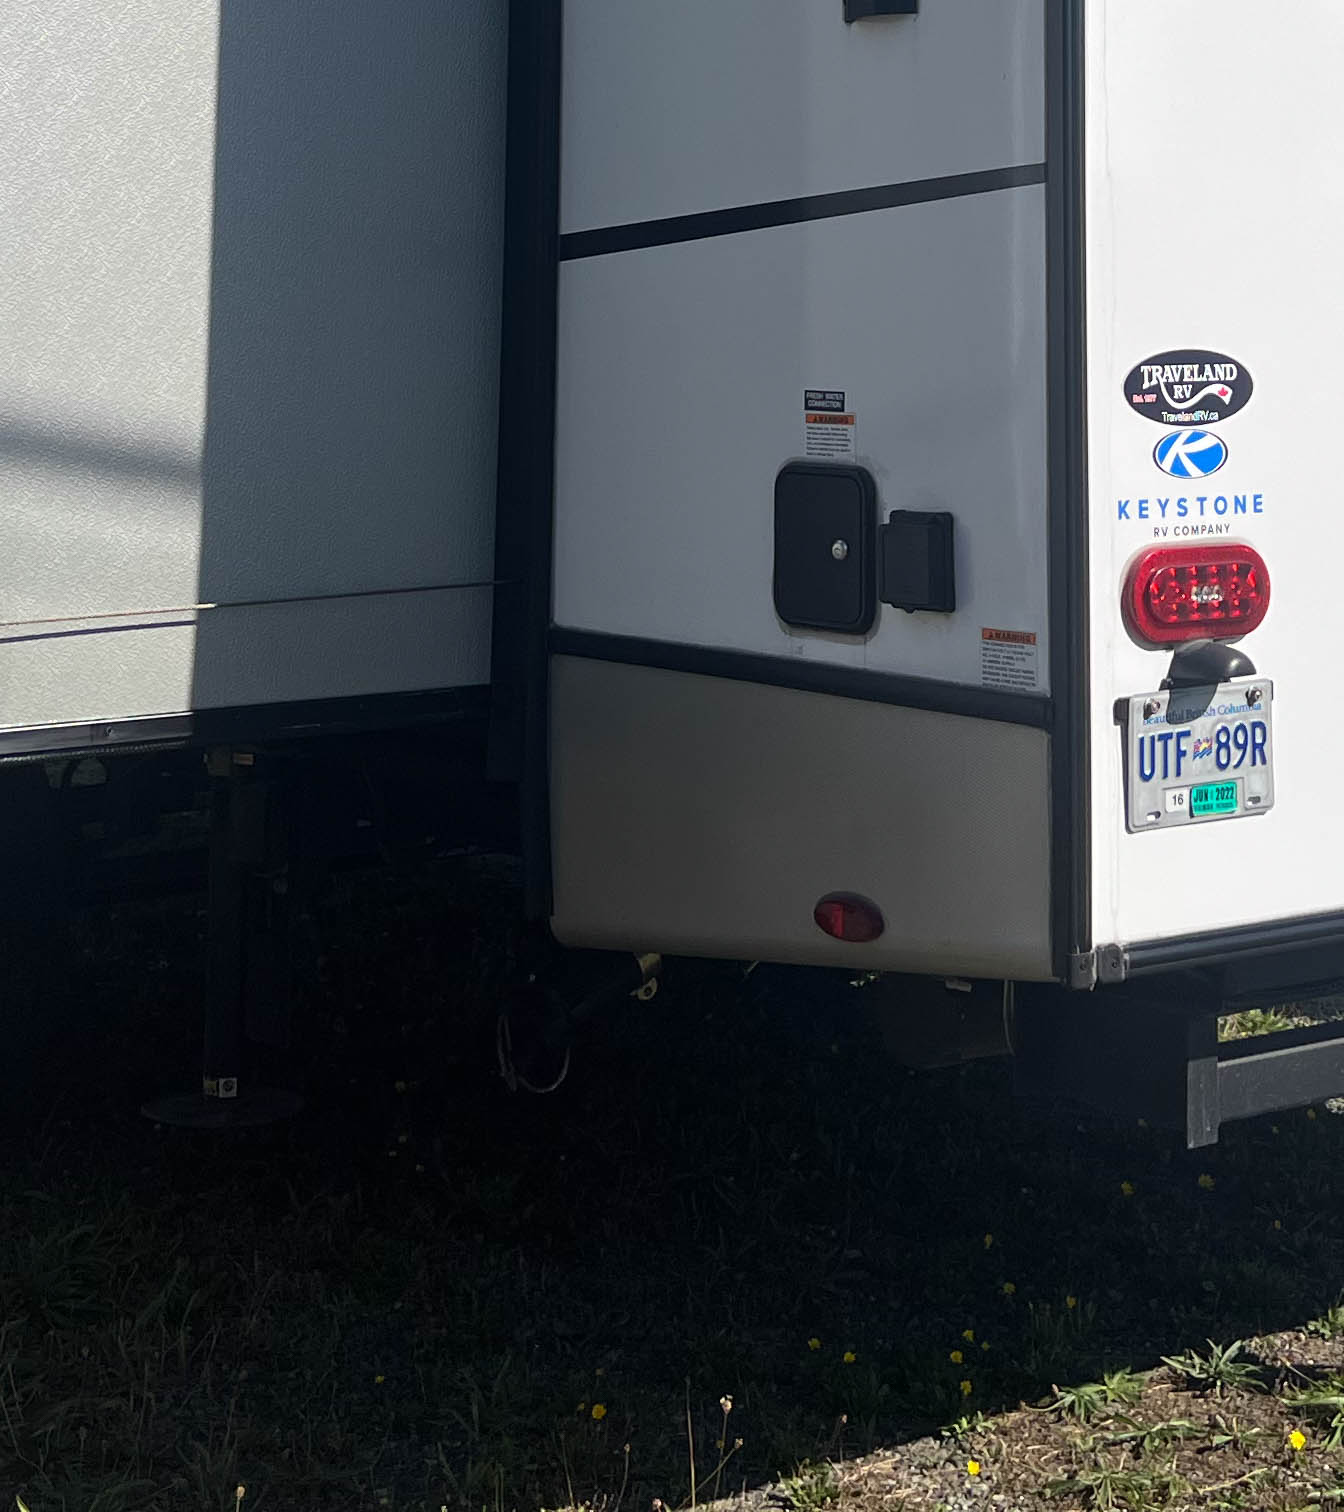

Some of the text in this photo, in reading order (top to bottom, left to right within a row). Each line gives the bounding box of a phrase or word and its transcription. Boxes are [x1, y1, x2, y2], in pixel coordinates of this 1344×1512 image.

[1140, 362, 1238, 390] TRAVELAND
[1173, 384, 1193, 400] RV
[1117, 493, 1264, 521] KEYSTONE
[1153, 523, 1231, 537] RV COMPANY
[1138, 720, 1267, 783] UTF 89R
[1172, 793, 1184, 806] 16
[1215, 786, 1234, 801] 2022
